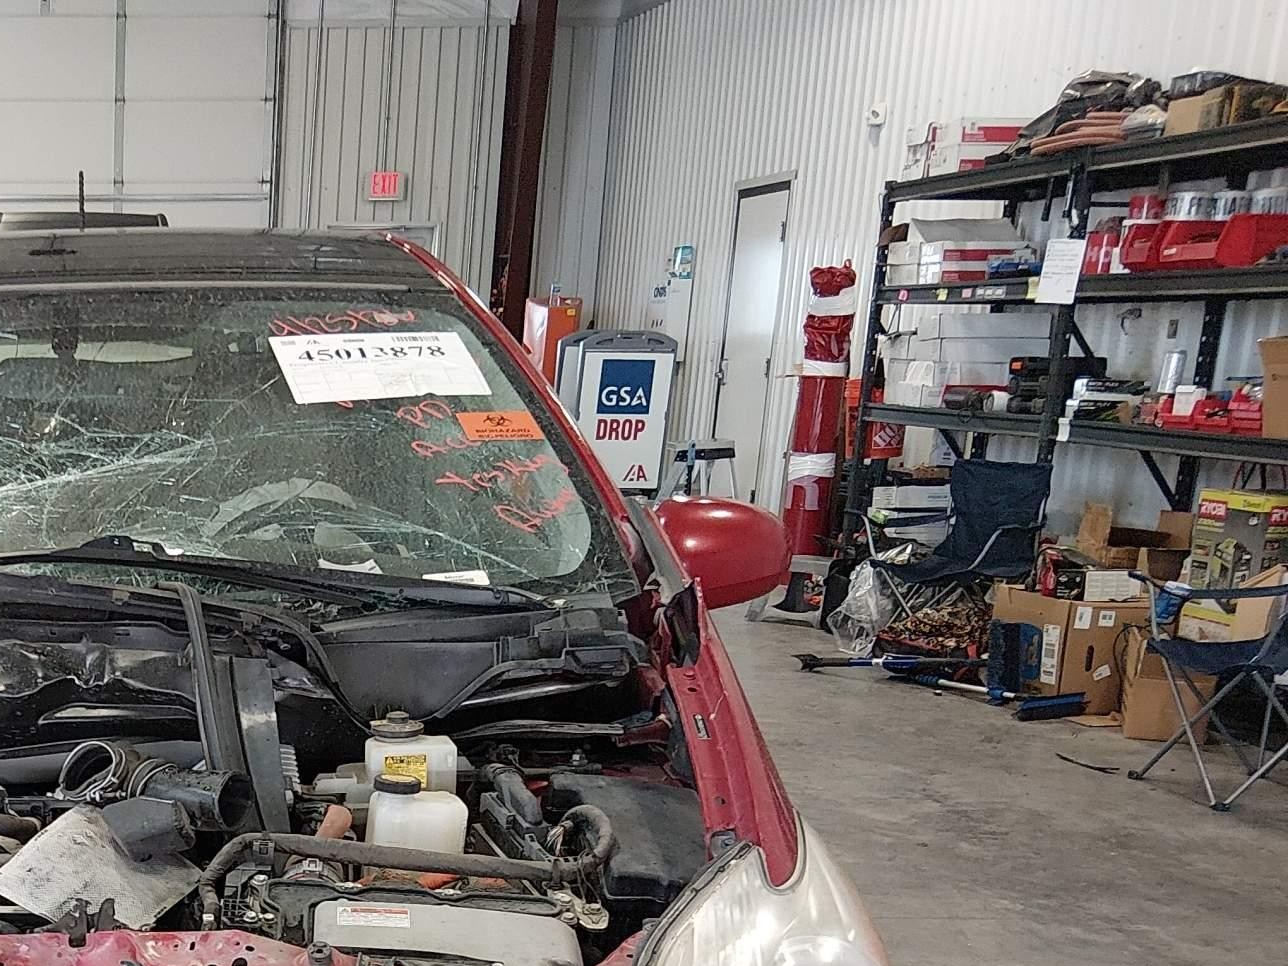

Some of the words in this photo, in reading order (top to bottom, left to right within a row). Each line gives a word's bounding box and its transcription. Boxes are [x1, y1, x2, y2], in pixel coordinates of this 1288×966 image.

[372, 174, 399, 195] EXIT
[298, 345, 446, 362] 45013878
[601, 386, 647, 407] GSA
[595, 419, 646, 441] DROP
